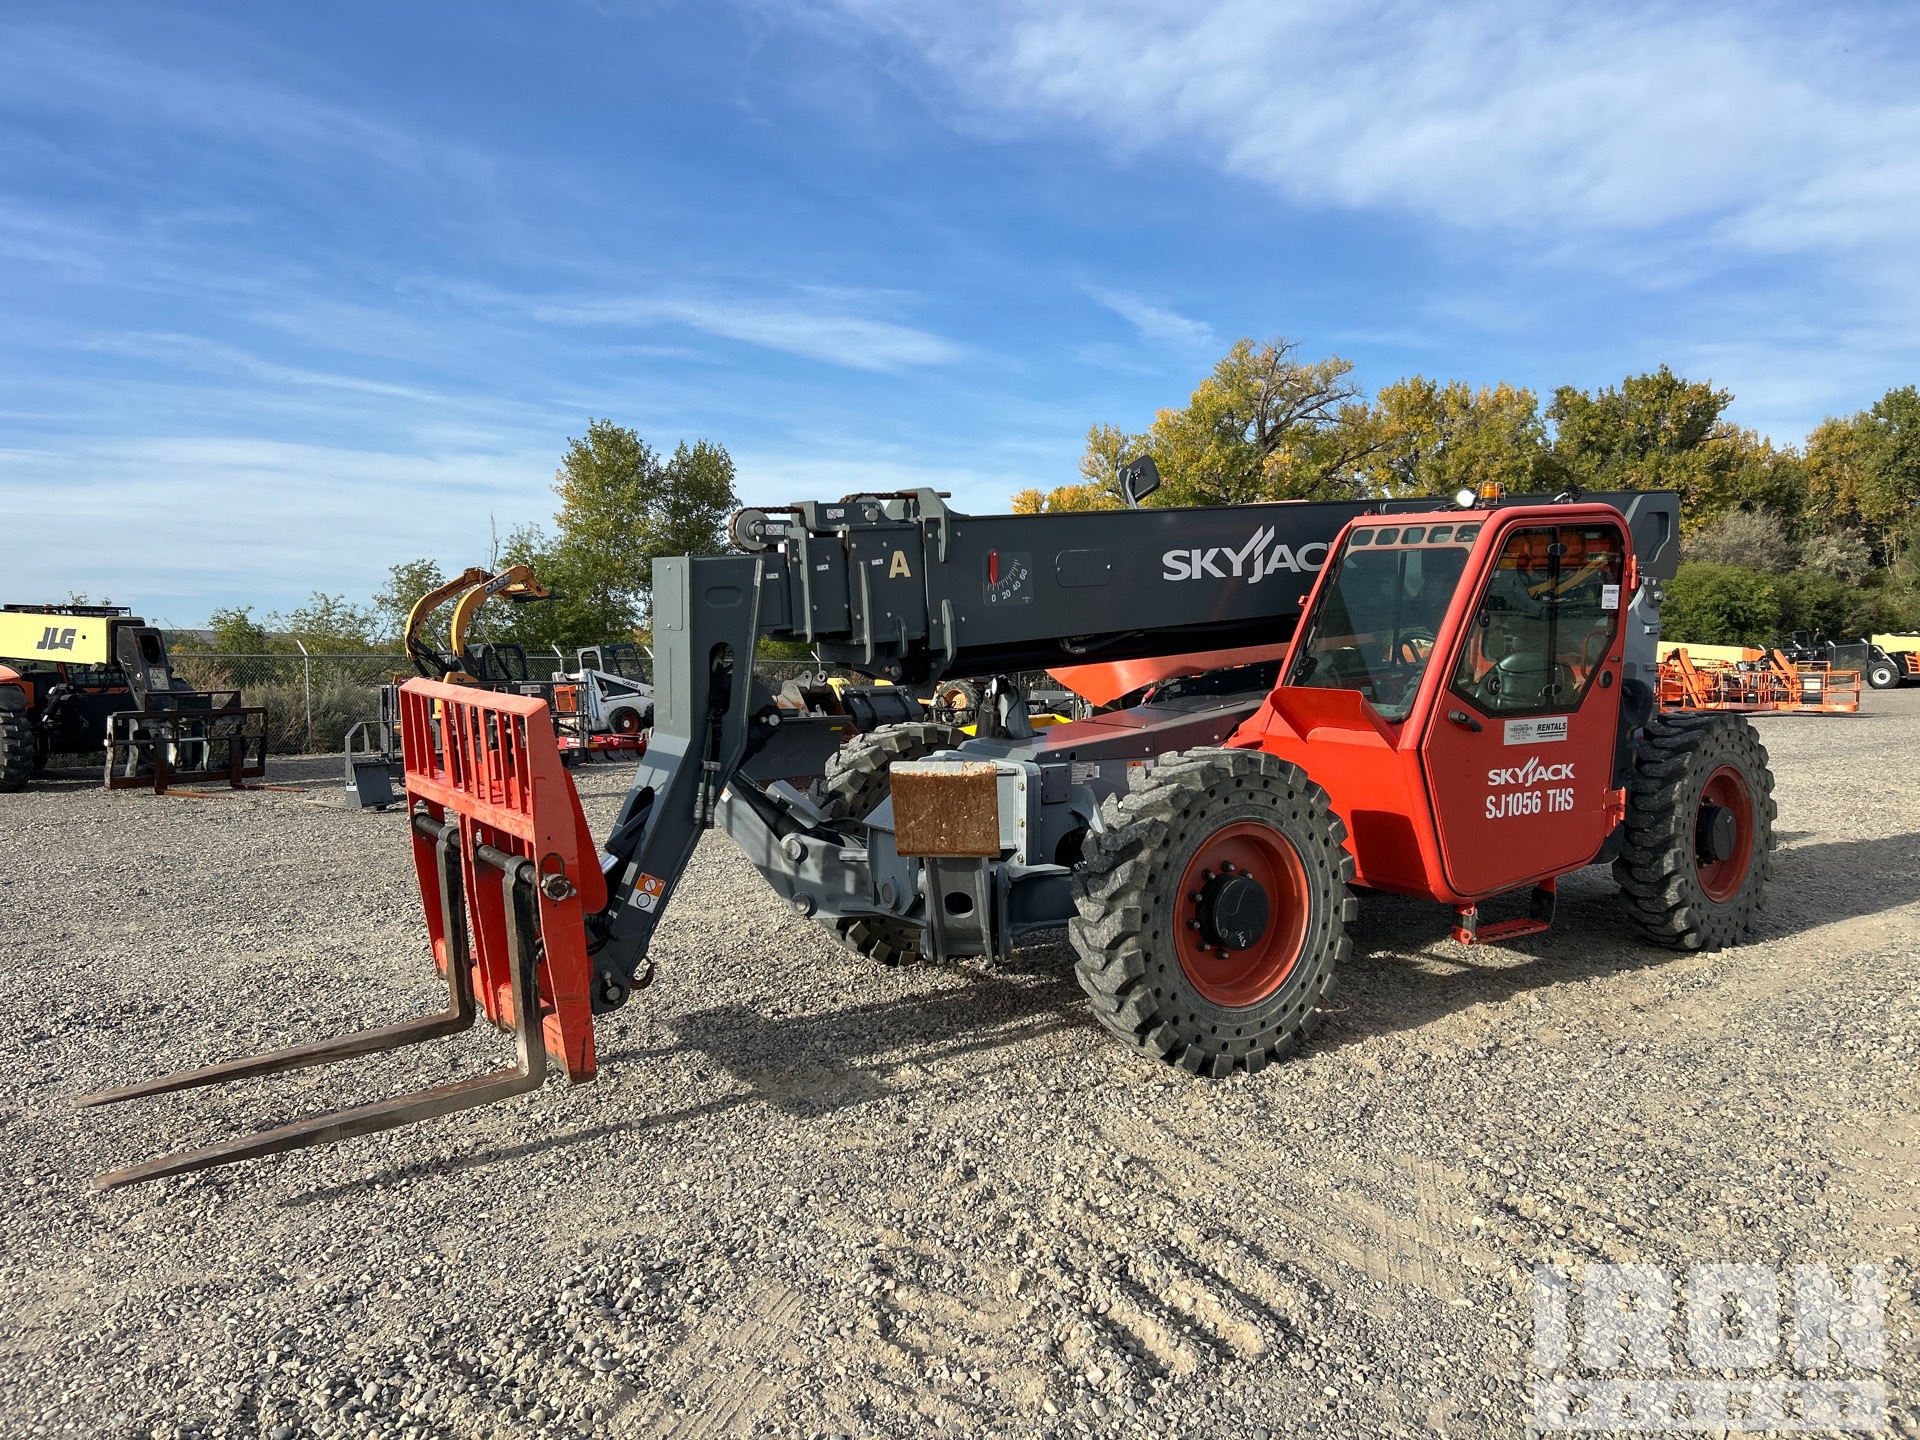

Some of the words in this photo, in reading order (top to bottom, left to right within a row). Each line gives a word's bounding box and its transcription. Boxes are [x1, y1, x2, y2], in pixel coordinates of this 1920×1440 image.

[888, 550, 911, 579] A
[1162, 524, 1334, 584] SKYJAC
[484, 573, 512, 594] CASE
[991, 594, 997, 603] 0
[1001, 589, 1011, 600] 20
[1012, 580, 1021, 591] 40
[1019, 568, 1028, 580] 60
[36, 627, 77, 651] JLG
[1536, 722, 1567, 732] RENTALS
[1487, 756, 1576, 788] SKYJACK
[1485, 790, 1542, 819] SJ1056
[1546, 787, 1574, 813] THS
